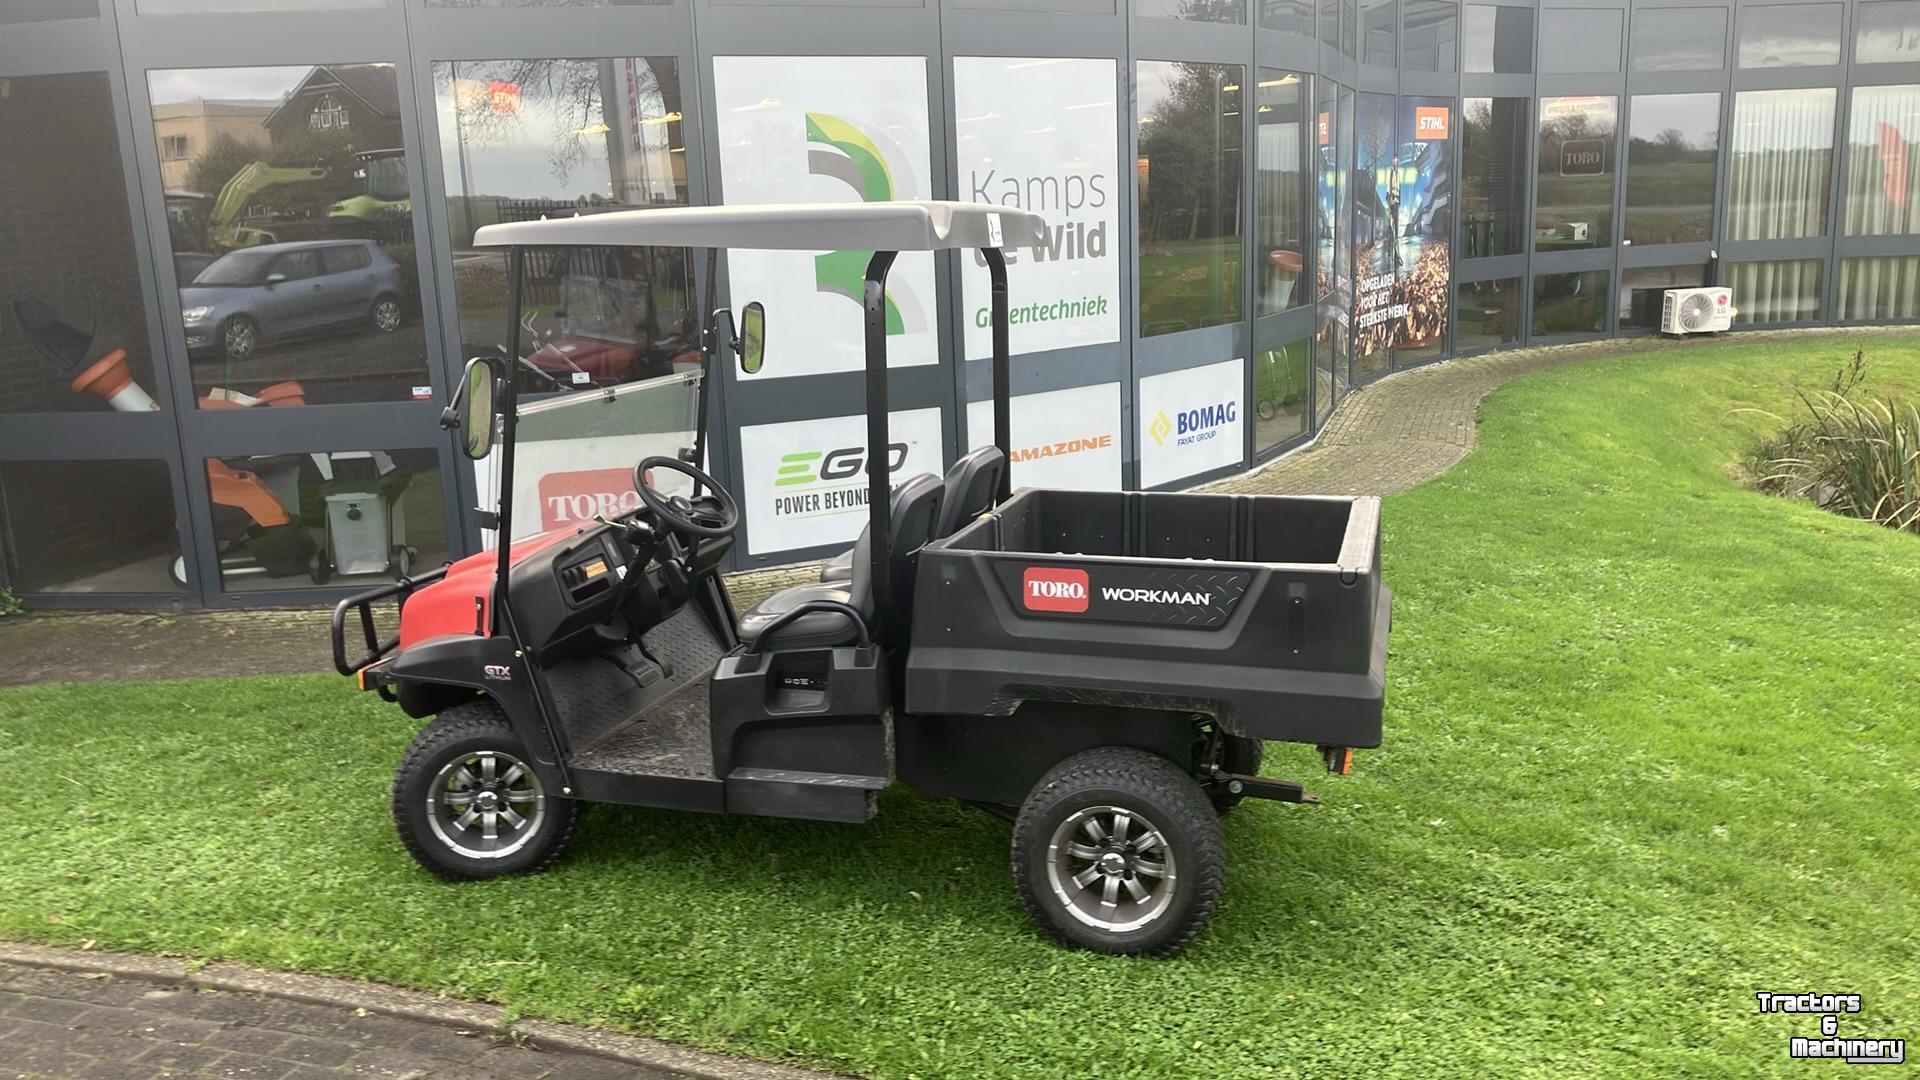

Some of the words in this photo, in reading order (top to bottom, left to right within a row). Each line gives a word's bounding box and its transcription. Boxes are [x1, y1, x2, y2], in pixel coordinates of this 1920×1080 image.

[1420, 116, 1445, 130] STIHL
[1566, 151, 1600, 165] TORO
[972, 169, 1106, 216] Kamps
[976, 295, 1108, 328] Gentechniek
[1177, 401, 1236, 435] BOMAG
[1177, 435, 1195, 446] FAYAT
[1196, 430, 1217, 442] GROUP
[1010, 435, 1112, 463] AMAZONE
[776, 493, 821, 516] POWER
[825, 489, 871, 510] BEYOND
[1028, 580, 1085, 599] TORO
[1102, 587, 1211, 606] WORKMAN
[484, 665, 511, 676] GTX
